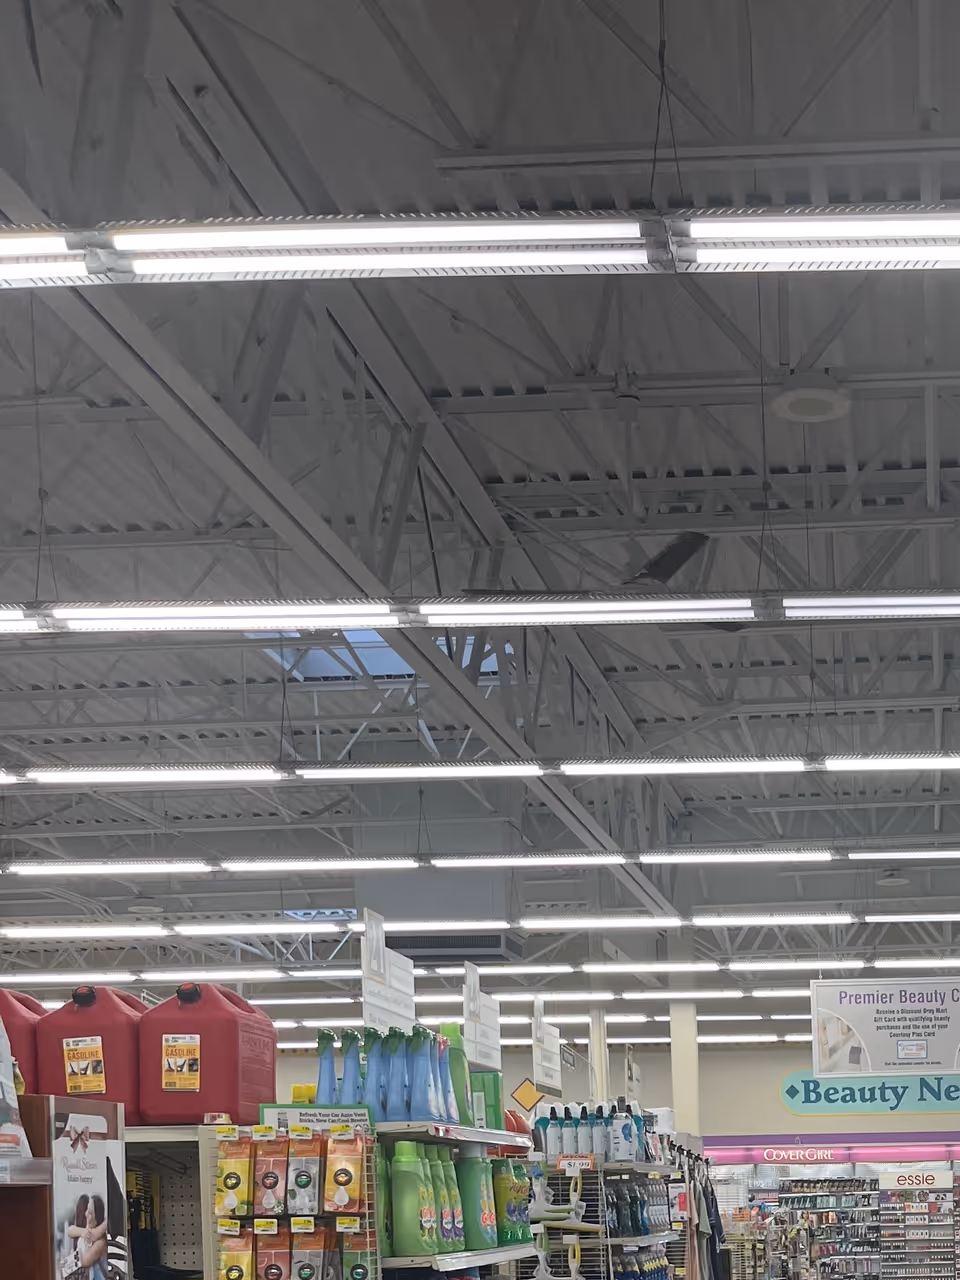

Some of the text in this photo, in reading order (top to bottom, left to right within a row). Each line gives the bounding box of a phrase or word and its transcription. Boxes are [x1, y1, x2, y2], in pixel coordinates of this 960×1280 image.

[839, 990, 894, 1006] Premier
[899, 989, 947, 1006] Beauty
[67, 1050, 100, 1060] GASOLINE
[165, 1048, 197, 1057] GASOLINE
[801, 1079, 909, 1111] Beauty
[896, 1172, 936, 1187] essie
